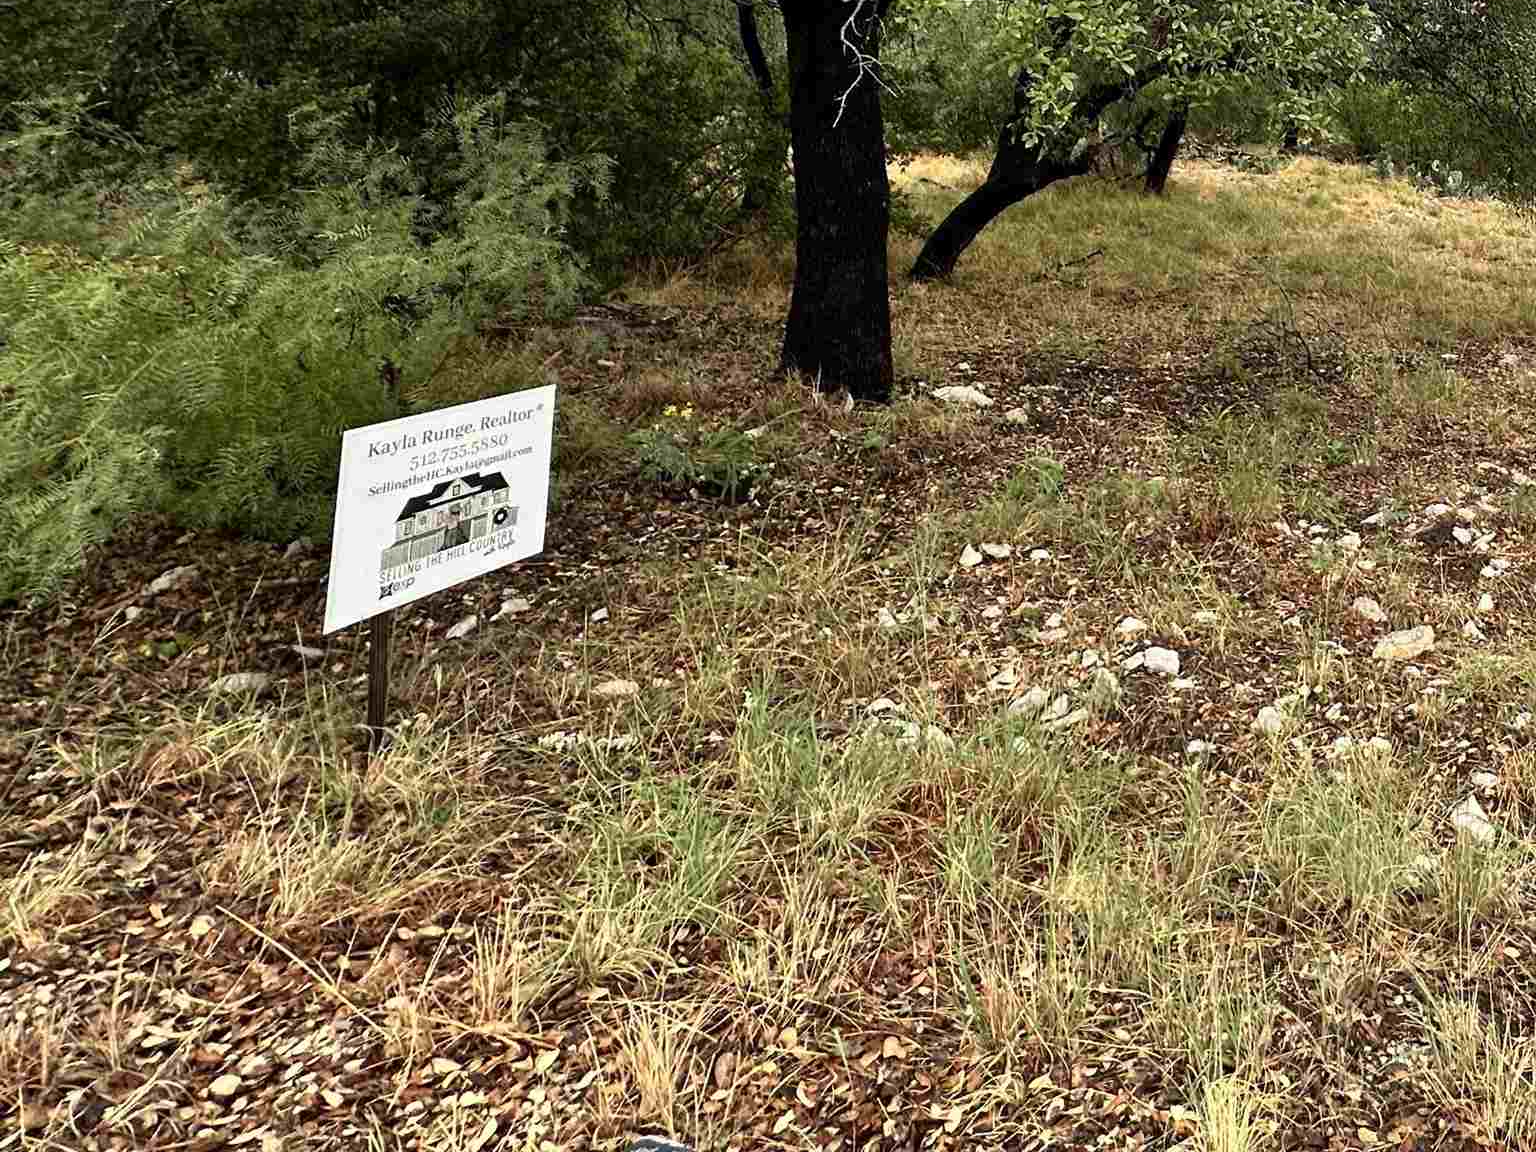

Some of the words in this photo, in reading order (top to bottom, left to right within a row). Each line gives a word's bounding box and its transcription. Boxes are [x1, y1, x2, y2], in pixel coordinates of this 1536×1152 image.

[367, 434, 417, 458] Kayla
[379, 560, 421, 585] SELLING
[426, 552, 442, 569] THE
[447, 545, 465, 562] HILL
